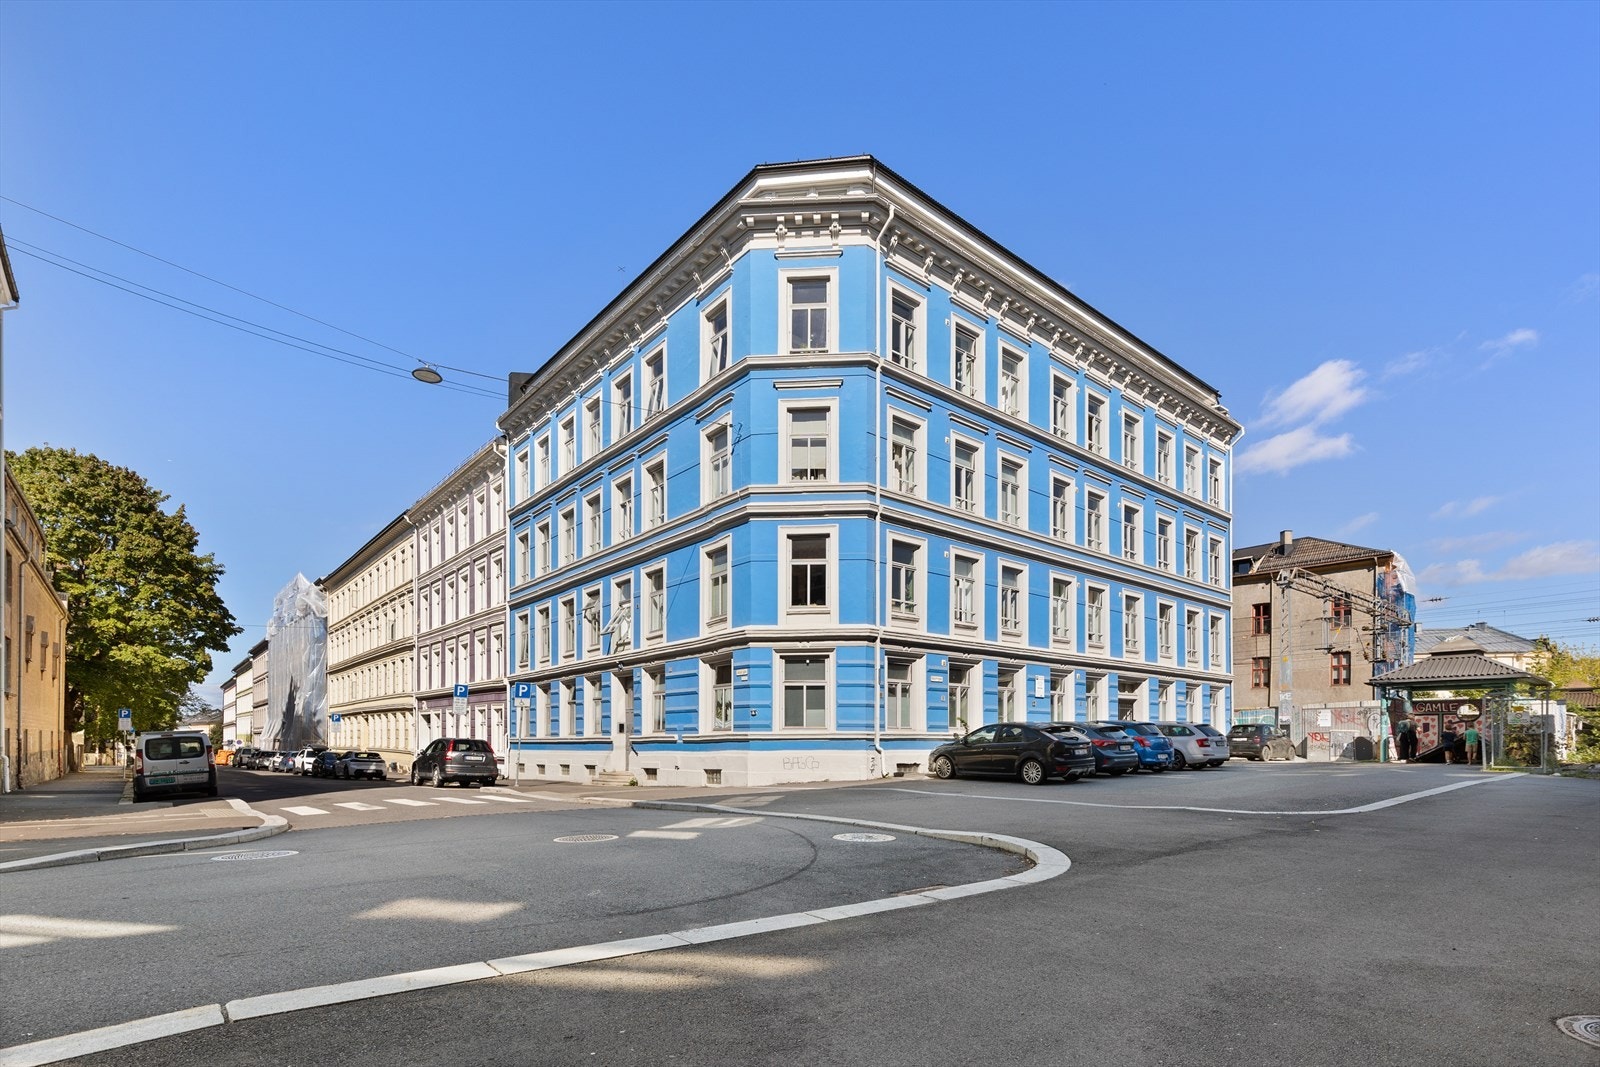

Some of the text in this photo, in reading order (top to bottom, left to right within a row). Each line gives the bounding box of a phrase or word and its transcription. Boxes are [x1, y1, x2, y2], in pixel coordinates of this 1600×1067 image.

[457, 686, 465, 696] P
[519, 685, 528, 696] P
[1416, 703, 1459, 712] GAMLE
